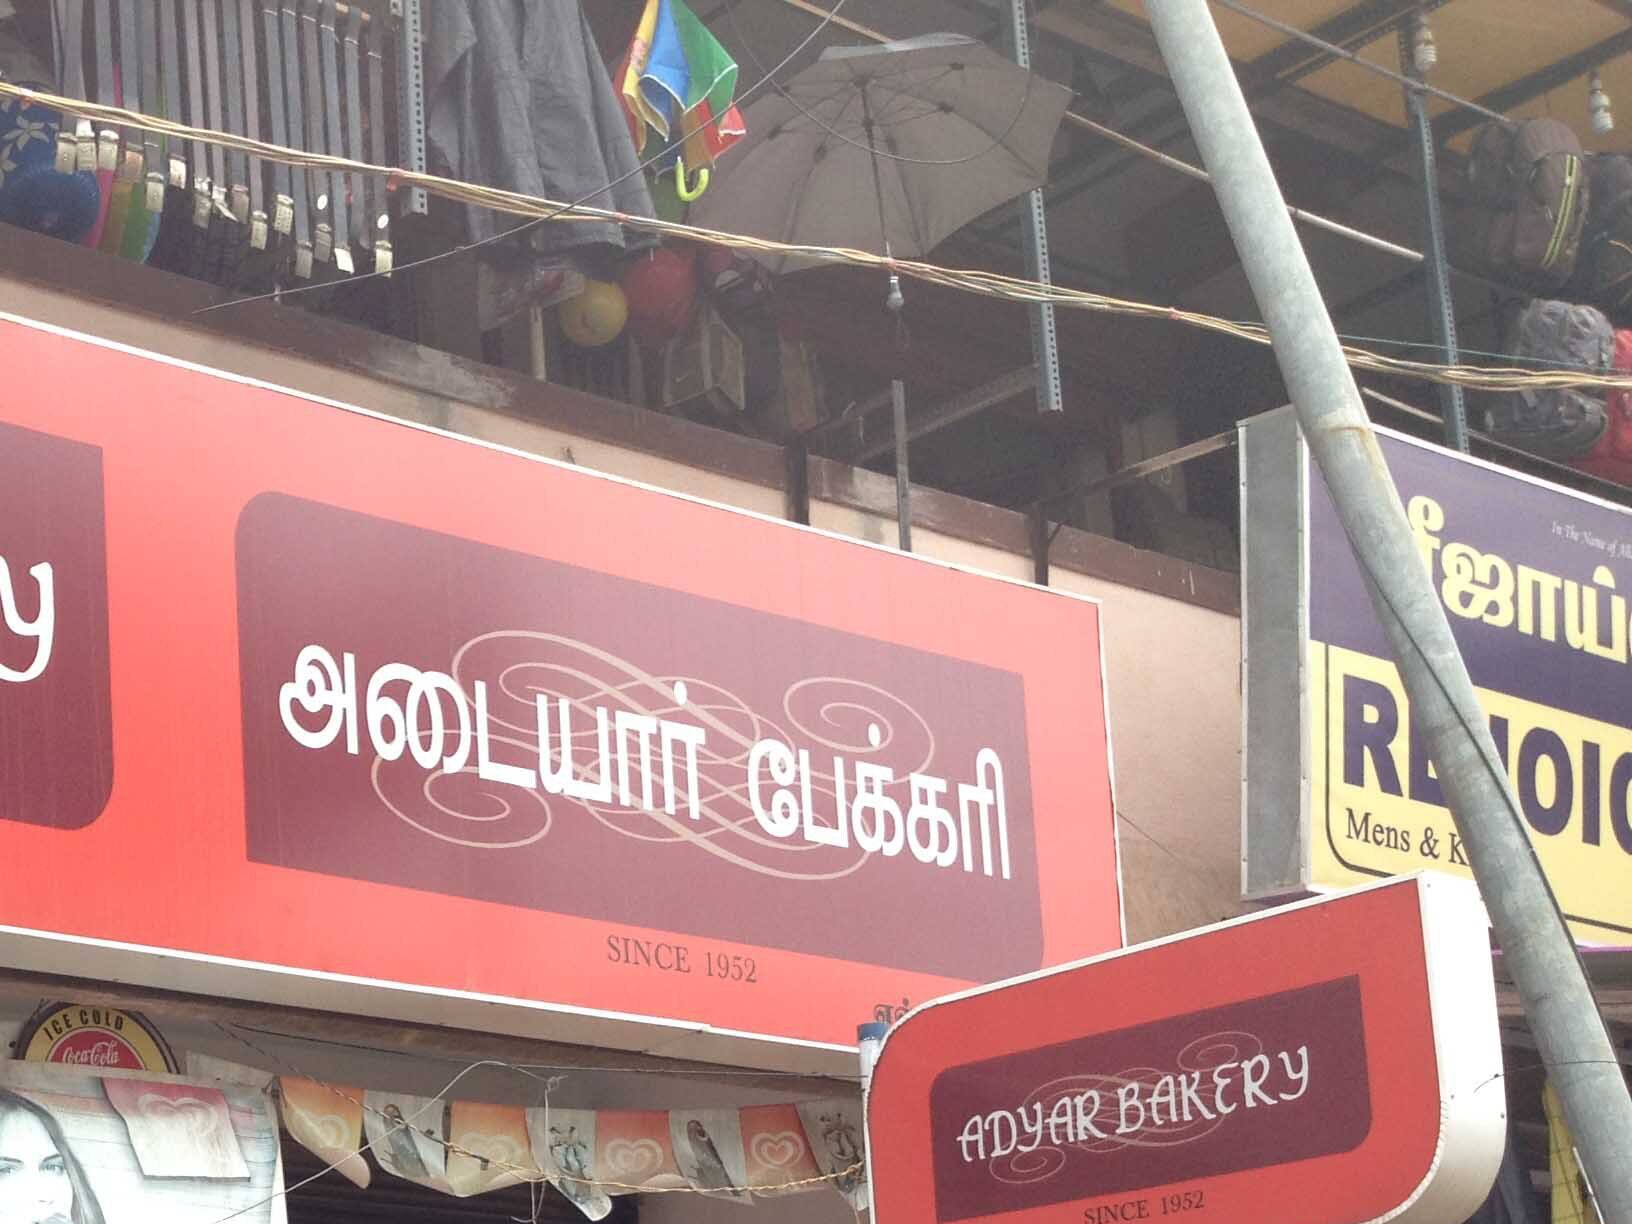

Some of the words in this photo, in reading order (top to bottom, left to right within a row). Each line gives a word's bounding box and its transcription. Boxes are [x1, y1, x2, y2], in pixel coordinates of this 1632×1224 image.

[278, 643, 706, 820] அடையார்
[748, 723, 1013, 880] பேக்கரி
[1345, 807, 1411, 852] Mens
[1419, 826, 1441, 860] &
[606, 933, 692, 974] SINCE
[703, 950, 759, 984] 1952
[43, 1013, 73, 1041] ICE
[79, 1009, 124, 1031] COLD
[955, 1088, 1107, 1164] ADYAR
[1115, 1045, 1311, 1133] BAKERY
[1159, 1191, 1206, 1217] 1952
